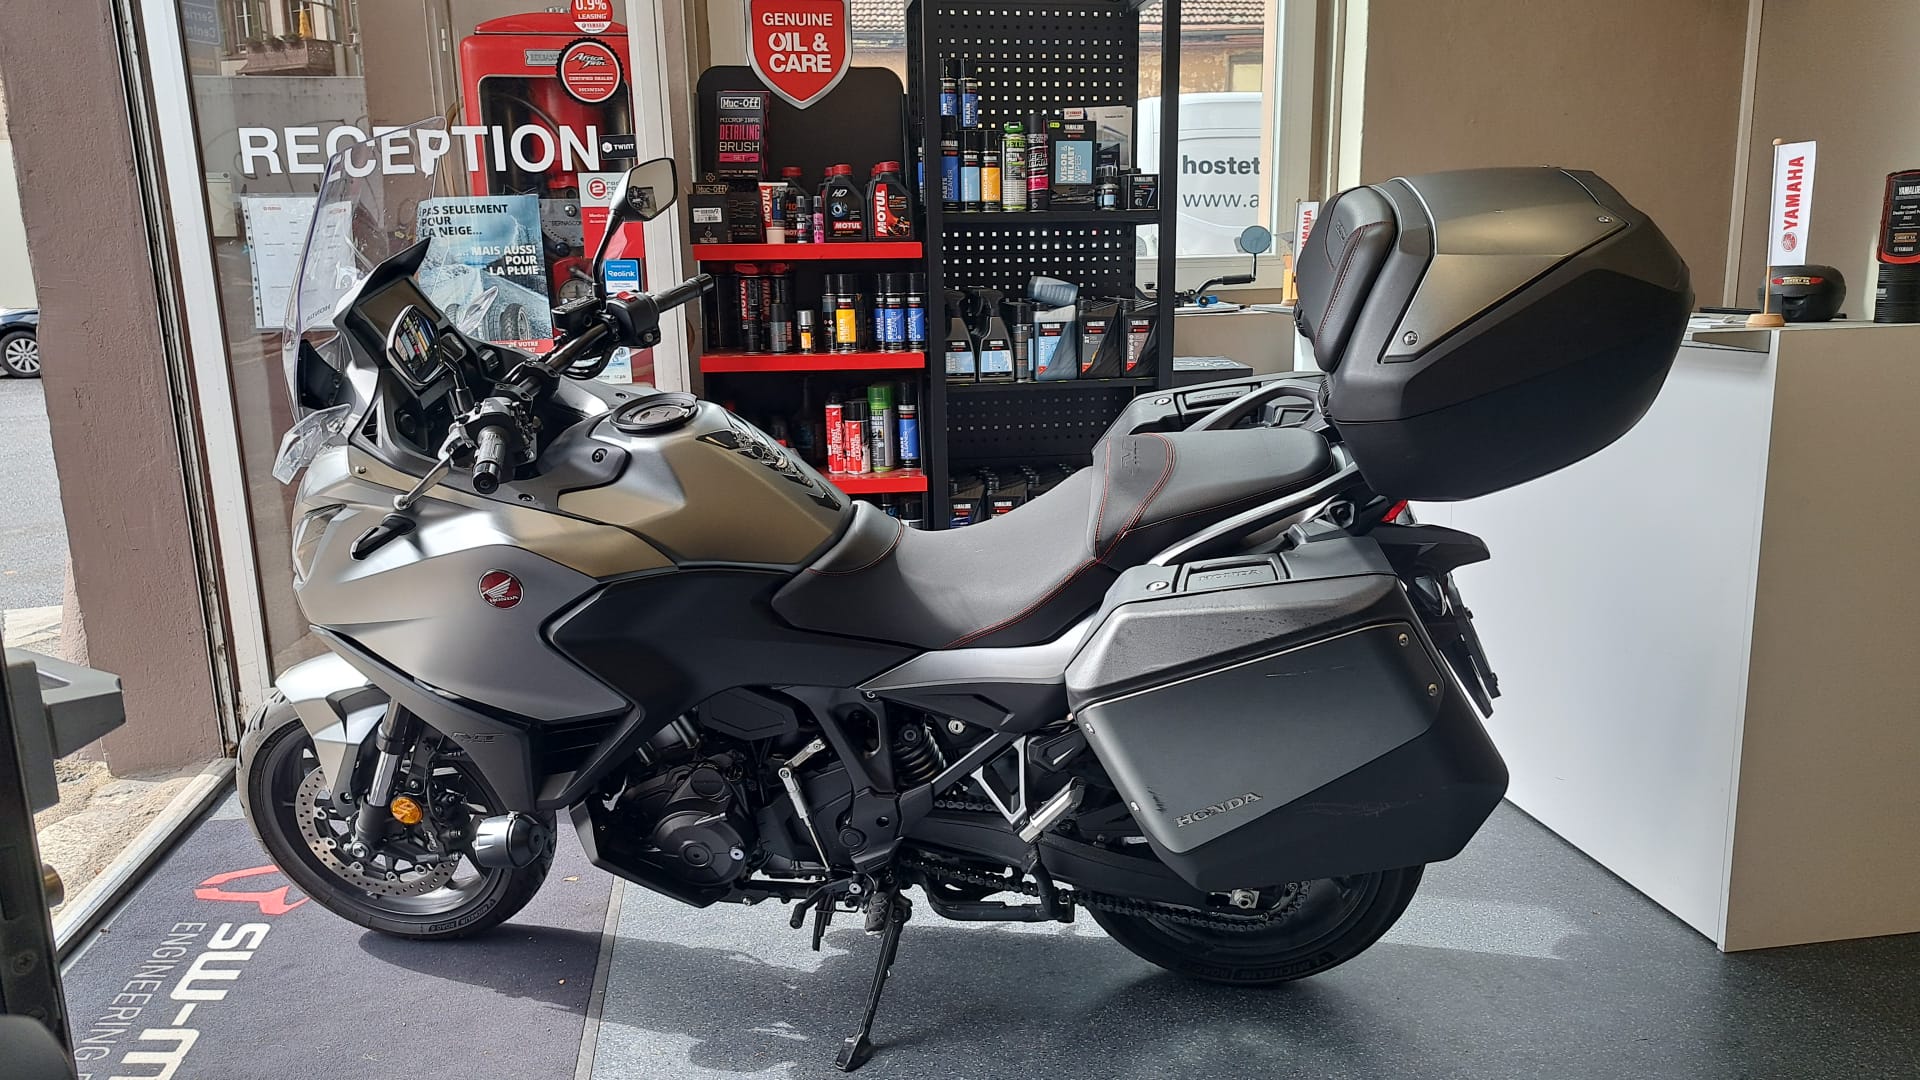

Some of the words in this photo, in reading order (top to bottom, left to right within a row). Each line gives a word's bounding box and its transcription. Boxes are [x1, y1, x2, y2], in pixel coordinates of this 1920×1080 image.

[762, 12, 833, 27] GENUINE
[768, 31, 808, 52] OIL
[812, 32, 830, 52] &
[569, 51, 606, 62] Africa
[769, 53, 832, 73] CARE
[722, 98, 759, 109] Muc-Off
[719, 124, 760, 140] DETAILING
[237, 124, 601, 178] RECEPTION
[719, 141, 760, 152] BRUSH
[1067, 145, 1075, 182] HELMET
[1182, 155, 1261, 175] hostet
[831, 188, 848, 198] HD
[1783, 155, 1805, 231] YAMAHA
[762, 187, 771, 223] MOTUL
[1182, 193, 1260, 209] www.a
[421, 205, 440, 217] PAS
[442, 203, 509, 215] SEULEMENT
[875, 189, 888, 234] MOTUL
[421, 216, 451, 227] POUR
[834, 221, 861, 230] MOTUL
[1301, 209, 1313, 248] AMAHA
[421, 227, 436, 238] LA
[471, 245, 501, 256] MAIS
[503, 244, 536, 256] AUSSI
[505, 255, 538, 265] POUR
[489, 266, 505, 276] LA
[507, 264, 540, 275] PLUIE
[607, 270, 636, 278] Reolink
[740, 280, 748, 318] MOTUL
[488, 594, 520, 604] HONDA
[1174, 791, 1264, 829] HONDA
[73, 922, 208, 1062] ENGINEERING
